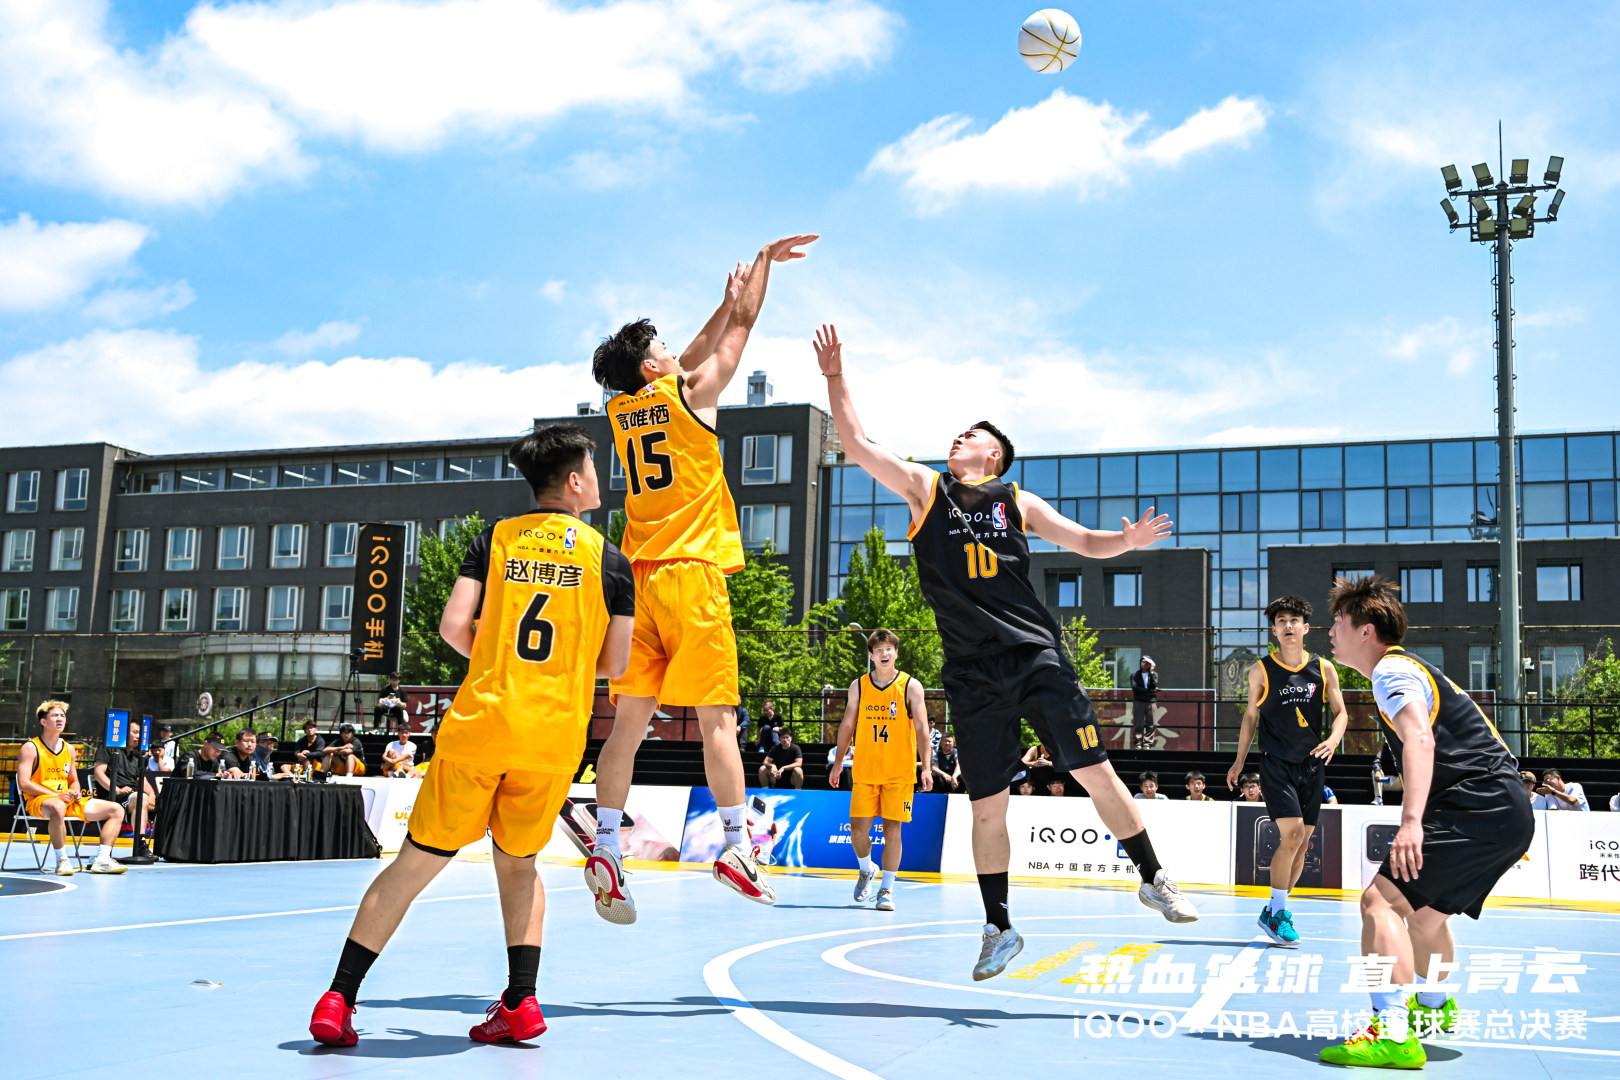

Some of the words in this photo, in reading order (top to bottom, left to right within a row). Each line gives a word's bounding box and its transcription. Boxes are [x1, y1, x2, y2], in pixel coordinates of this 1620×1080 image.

[615, 403, 670, 431] 高唯栖
[627, 431, 674, 496] 15
[948, 507, 983, 523] iQOO
[518, 529, 556, 540] iQOO
[962, 527, 1007, 539] 中官方手机
[964, 542, 998, 579] 10
[504, 558, 583, 588] 赵博彦
[515, 591, 556, 664] 6
[1279, 686, 1304, 696] iQOO
[873, 724, 889, 743] 14
[1076, 725, 1098, 750] 10
[903, 801, 912, 812] 14
[839, 823, 852, 832] iQ
[1030, 826, 1098, 845] iQOO
[1028, 861, 1050, 870] NBA
[1054, 862, 1135, 874] 中国官方手机
